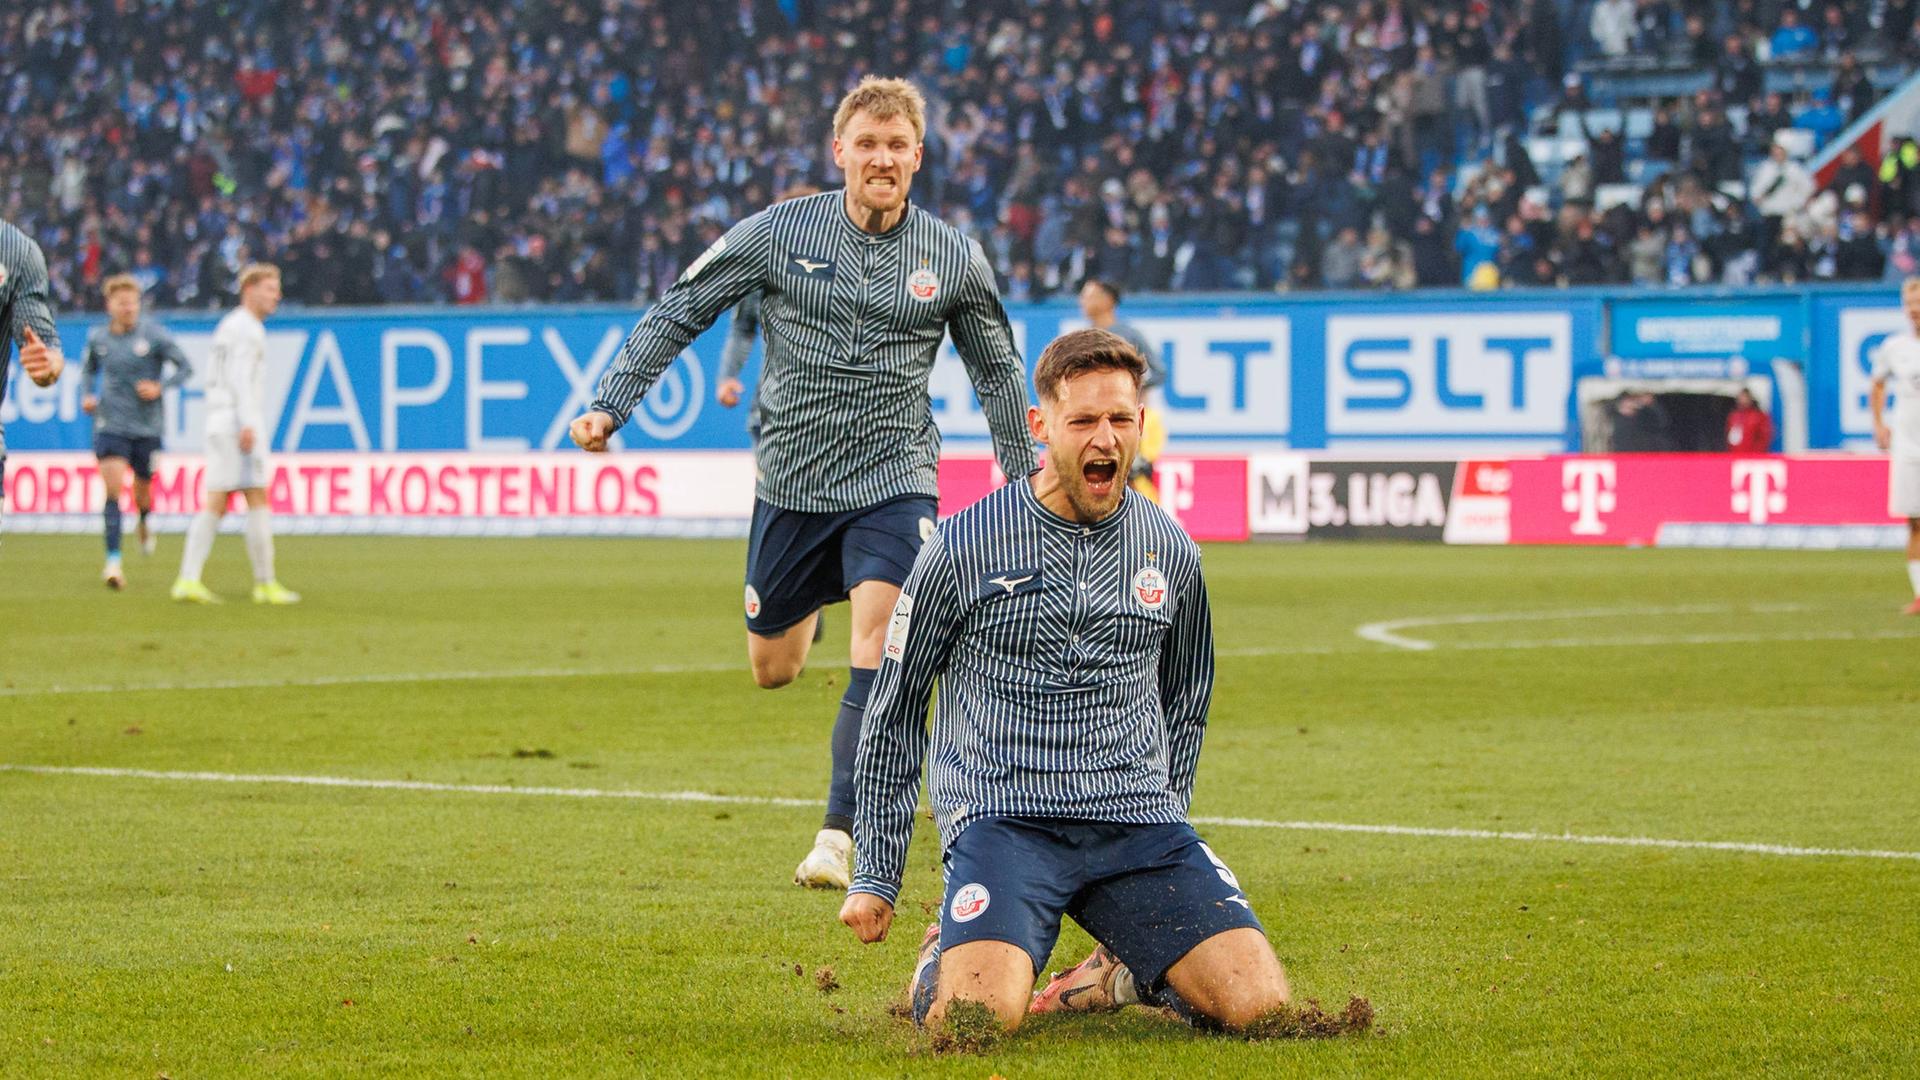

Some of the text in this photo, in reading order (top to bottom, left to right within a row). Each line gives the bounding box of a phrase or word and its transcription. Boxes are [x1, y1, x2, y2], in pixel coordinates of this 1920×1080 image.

[283, 326, 628, 451] APEX
[1162, 341, 1272, 411] LT
[1345, 337, 1553, 411] SLT
[369, 465, 661, 516] KOSTENLOS
[1307, 471, 1348, 528] 3.
[1348, 471, 1446, 528] LIGA
[1561, 459, 1618, 536] T
